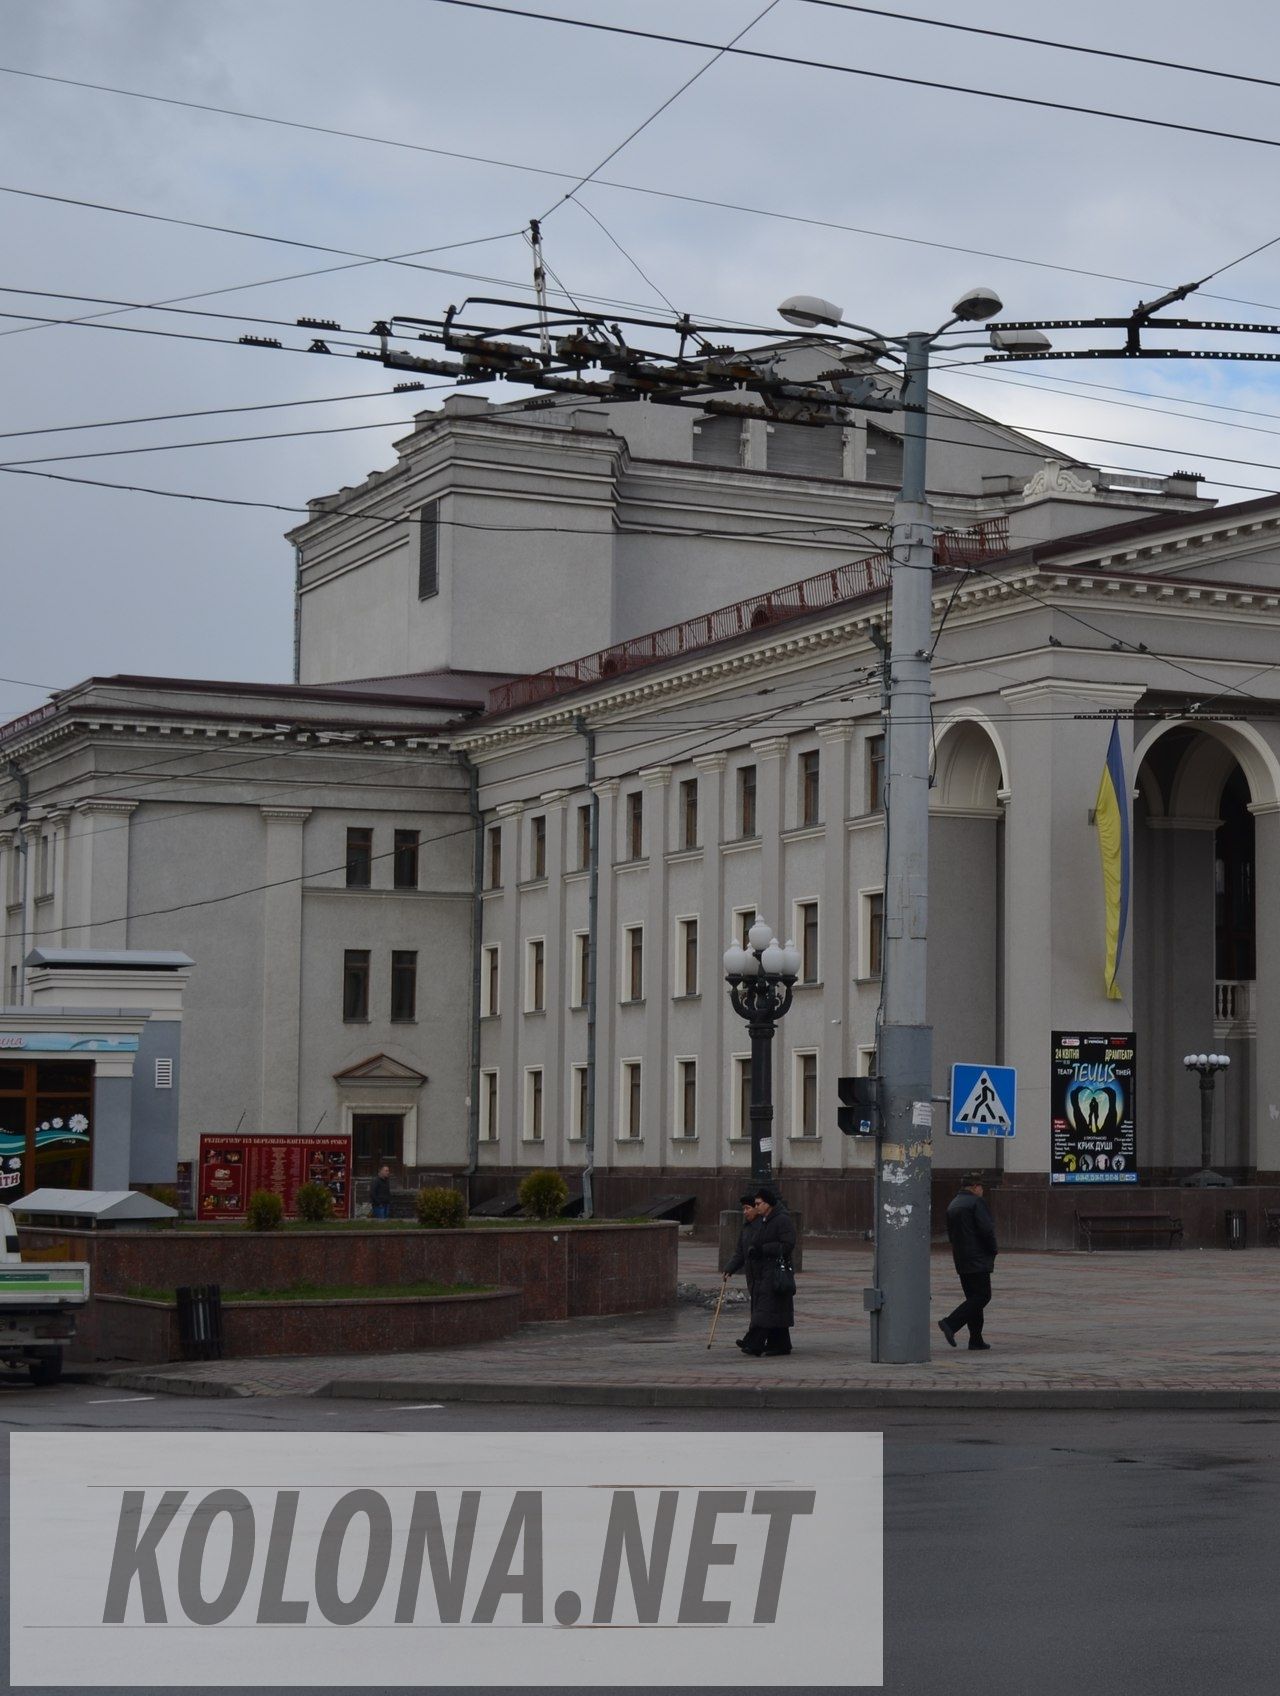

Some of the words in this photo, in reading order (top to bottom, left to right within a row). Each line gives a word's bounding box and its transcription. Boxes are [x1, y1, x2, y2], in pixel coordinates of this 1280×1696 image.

[1055, 1048, 1062, 1059] 24
[1062, 1048, 1080, 1059] КВІТНЯ
[1104, 1049, 1134, 1062] ДРАМТЕАТР
[1072, 1062, 1116, 1082] TEULIS
[1077, 1141, 1095, 1150] КРИК
[1095, 1141, 1113, 1151] ДУШІ
